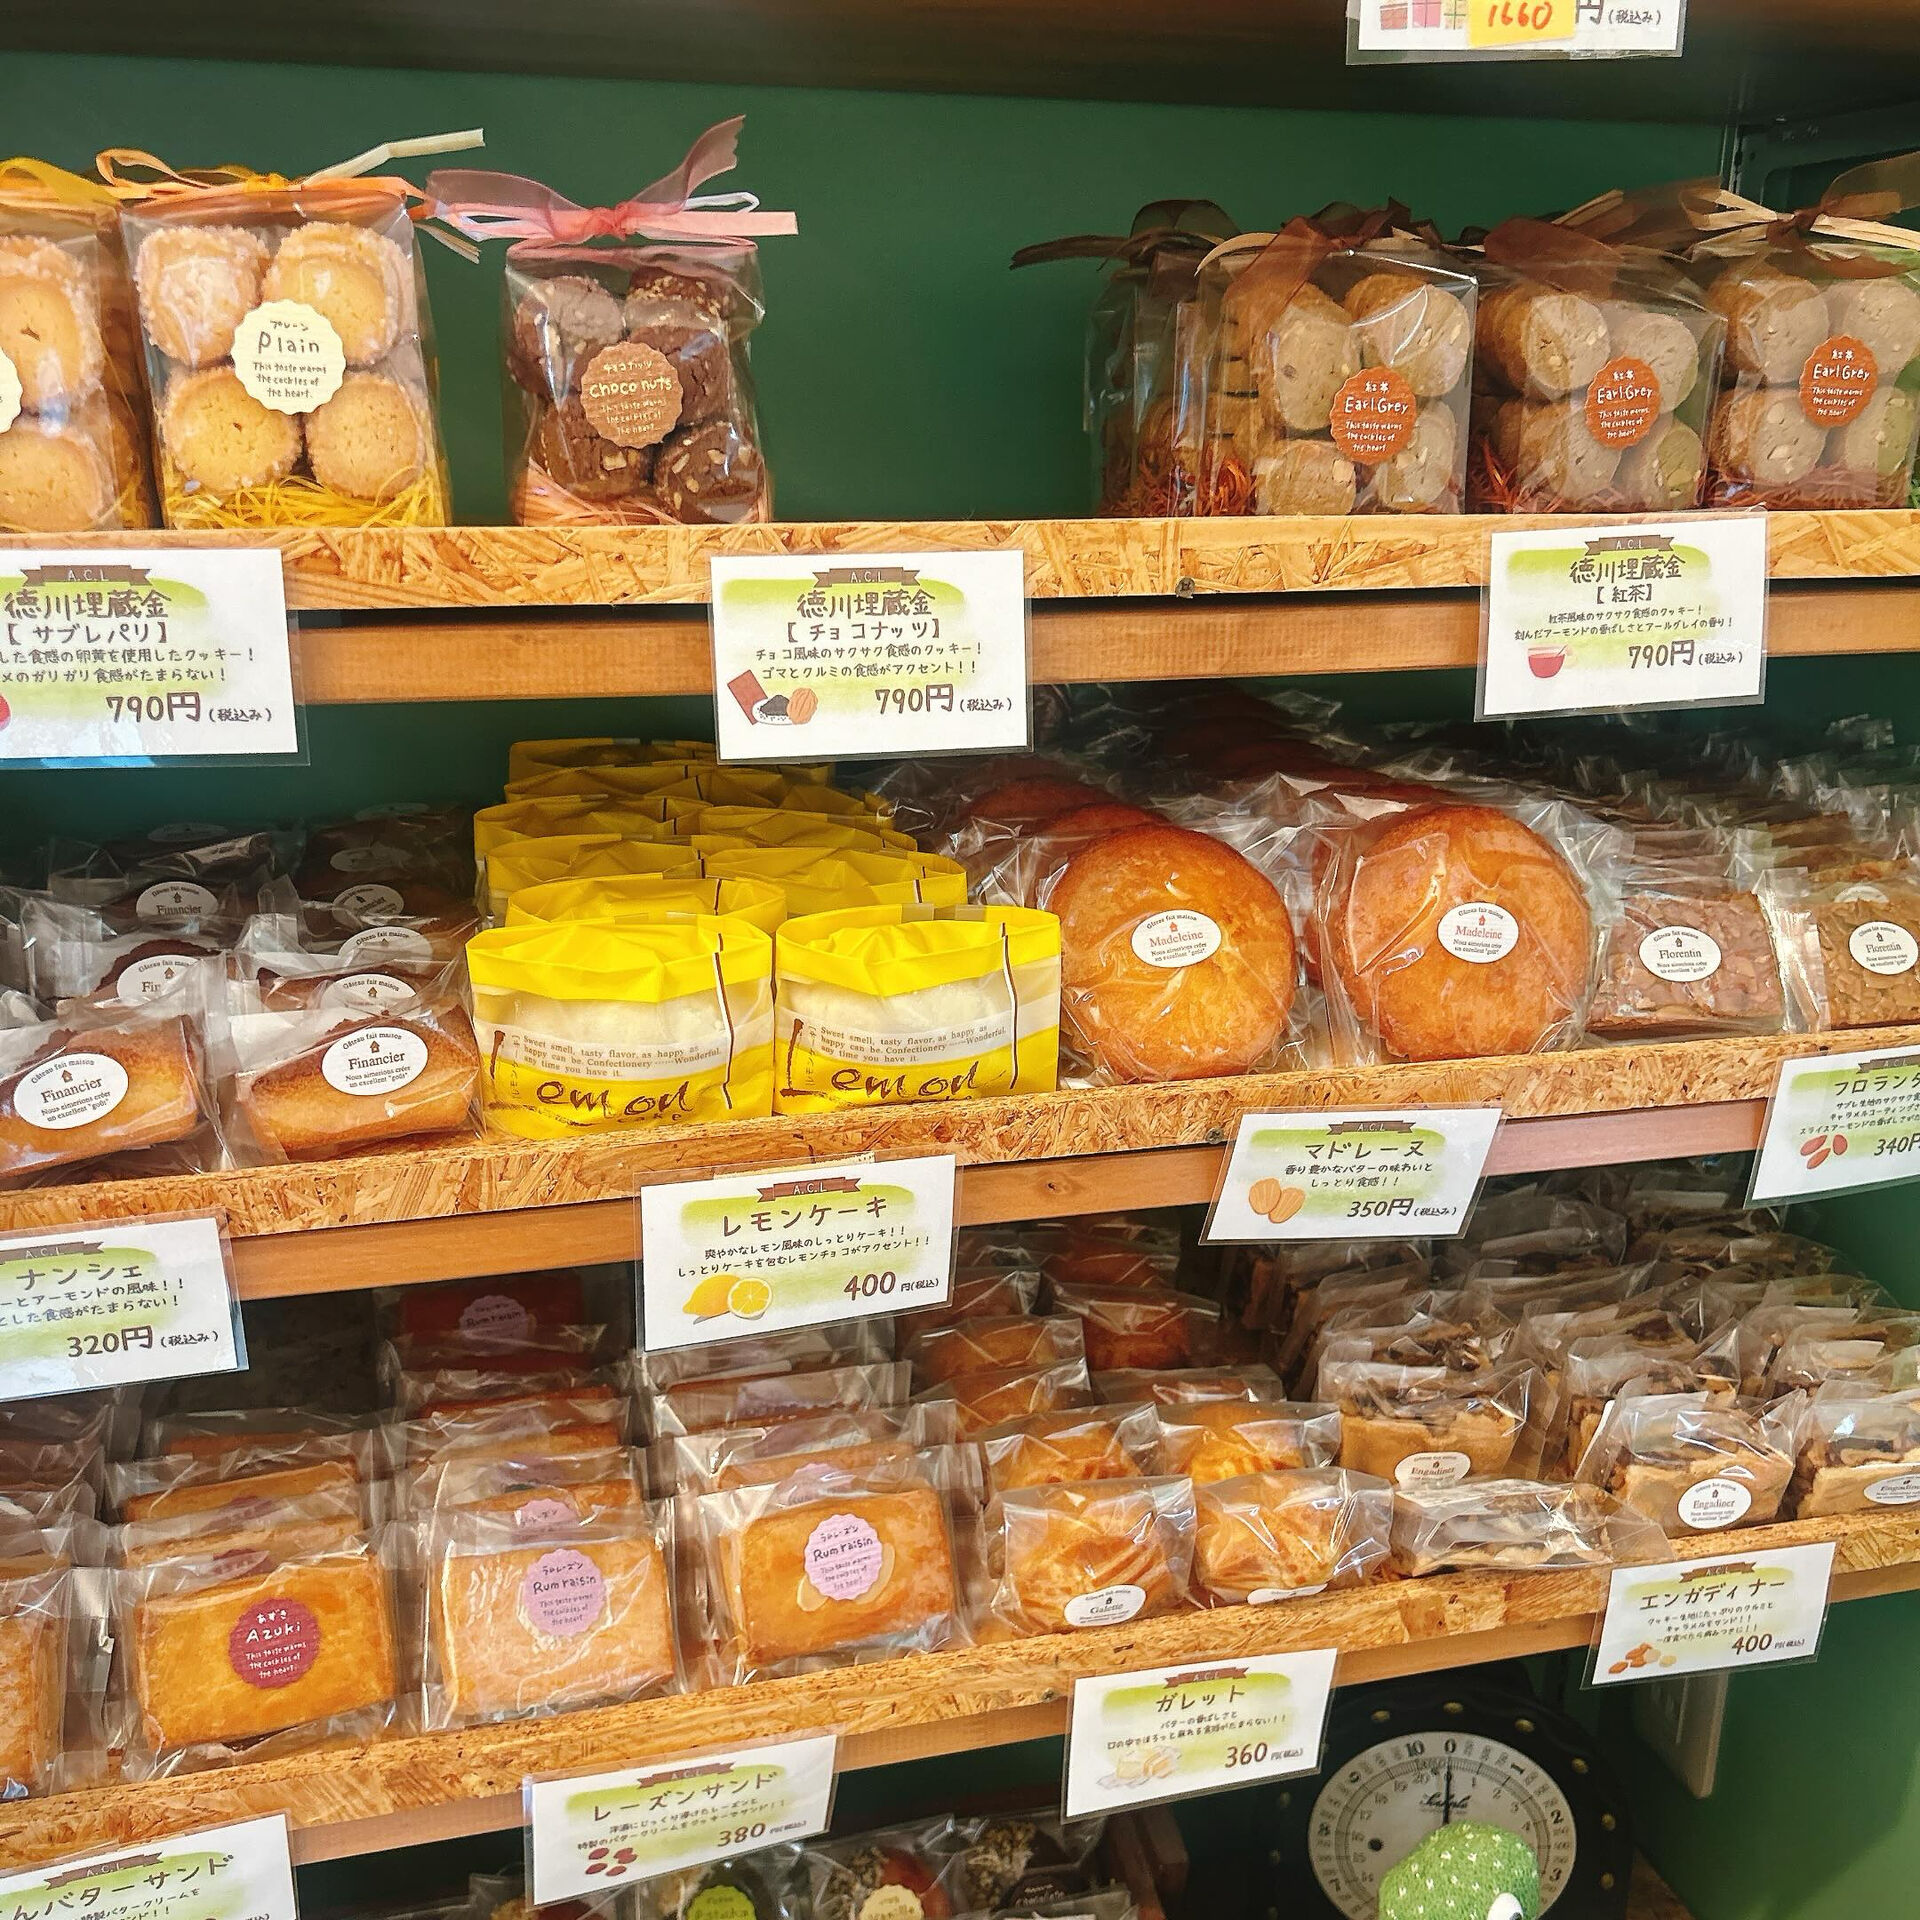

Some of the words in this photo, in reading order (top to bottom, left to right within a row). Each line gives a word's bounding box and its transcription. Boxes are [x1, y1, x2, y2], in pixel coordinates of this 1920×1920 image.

[1488, 4, 1552, 30] 1660
[1608, 10, 1661, 25] (税込み)
[270, 319, 309, 331] プレーン
[258, 331, 320, 354] Plain
[253, 361, 272, 372] This
[274, 363, 297, 373] taste
[299, 364, 327, 374] warms
[256, 374, 271, 384] the
[273, 375, 307, 386] cockles
[310, 377, 320, 387] of
[589, 382, 637, 398] Choco
[640, 376, 673, 391] nuts
[267, 387, 281, 398] the
[1569, 555, 1685, 583] 徳川埋蔵金
[5, 589, 172, 620] 徳川埋蔵金
[797, 589, 935, 619] 徳川埋蔵金
[755, 643, 982, 661] チョコ風味のサクサク食感のクッキー！
[1628, 639, 1695, 669] 790円
[1699, 650, 1743, 665] (税込み)
[762, 661, 977, 680] ゴマとクルミの食感がアクセント！！
[106, 691, 201, 723] 790円
[209, 707, 272, 722] (税込み)
[875, 683, 953, 715] 790円
[959, 697, 1012, 712] (税込み)
[1149, 930, 1204, 948] Madeleine
[1455, 925, 1503, 940] Madeleine
[1658, 948, 1702, 960] Florentin
[821, 1026, 845, 1039] Sweet
[880, 1038, 901, 1046] tasty
[951, 1028, 975, 1040] happy
[821, 1035, 845, 1049] happy
[850, 1044, 865, 1052] can
[885, 1043, 946, 1055] Confectionery
[523, 1035, 546, 1049] Sweet
[581, 1049, 603, 1058] tasty
[657, 1047, 685, 1060] happy
[523, 1044, 547, 1058] happy
[551, 1054, 566, 1062] can
[587, 1058, 653, 1069] Confectionery
[821, 1045, 834, 1055] any
[839, 1049, 859, 1059] time
[862, 1055, 879, 1063] you
[884, 1054, 905, 1063] have
[348, 1052, 405, 1070] Financier
[523, 1056, 537, 1066] any
[541, 1060, 561, 1070] time
[564, 1066, 581, 1075] you
[586, 1067, 607, 1076] have
[40, 1077, 103, 1104] Financier
[1304, 1140, 1424, 1160] マドレーヌ
[1284, 1162, 1433, 1176] 香り豊かなバターの味わいと
[1311, 1176, 1400, 1188] しっとり食感！！
[722, 1196, 888, 1238] レモンケーキ
[1347, 1197, 1415, 1218] 350円
[1413, 1206, 1458, 1217] (税込み)
[704, 1225, 906, 1260] 爽やかなレモン風味のしっとりケーキ！！
[16, 1262, 142, 1291] ナンシェ
[843, 1271, 896, 1301] 400
[66, 1325, 153, 1358] 320円
[160, 1330, 219, 1348] (税込み)
[533, 1581, 559, 1595] Rum
[562, 1575, 597, 1589] raisin
[1640, 1578, 1786, 1611] エンガディナー
[257, 1609, 287, 1624] あずき
[246, 1621, 301, 1643] Azuki
[1731, 1633, 1773, 1655] 400
[1156, 1685, 1245, 1713] ガレット
[1225, 1741, 1268, 1768] 360
[1406, 1740, 1425, 1757] 10
[1445, 1738, 1456, 1754] 0
[593, 1771, 778, 1822] レーズンサンド
[717, 1822, 766, 1847] 380
[0, 1854, 234, 1920] んバターサンド
